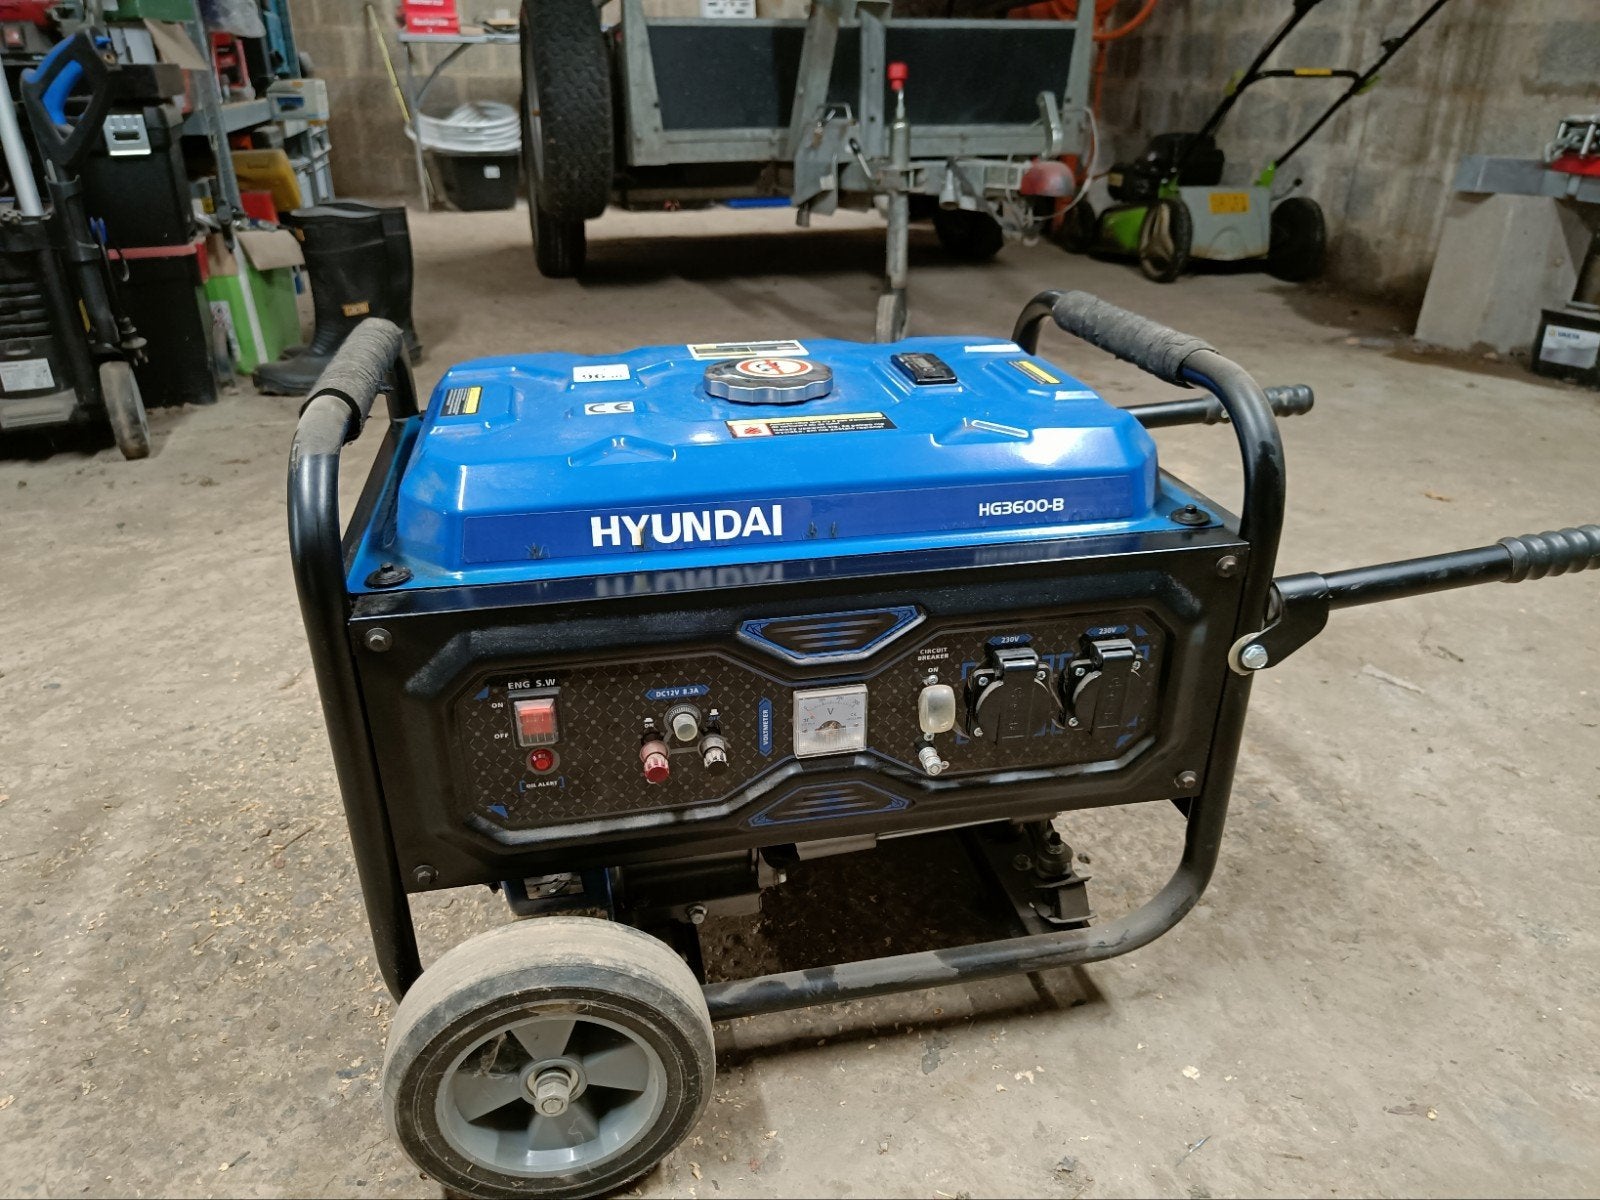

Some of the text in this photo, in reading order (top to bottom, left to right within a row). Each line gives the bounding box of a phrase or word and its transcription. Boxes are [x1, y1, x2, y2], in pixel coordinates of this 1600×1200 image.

[588, 402, 632, 413] CE
[979, 498, 1064, 516] HG3600-B
[591, 505, 782, 547] HYUNDAI
[1099, 627, 1117, 635] 230V
[1001, 636, 1020, 644] 230V
[920, 647, 948, 655] CIRCUIT
[918, 653, 949, 661] BREAKER
[508, 679, 556, 690] ENG S.W
[656, 690, 680, 698] DC12V
